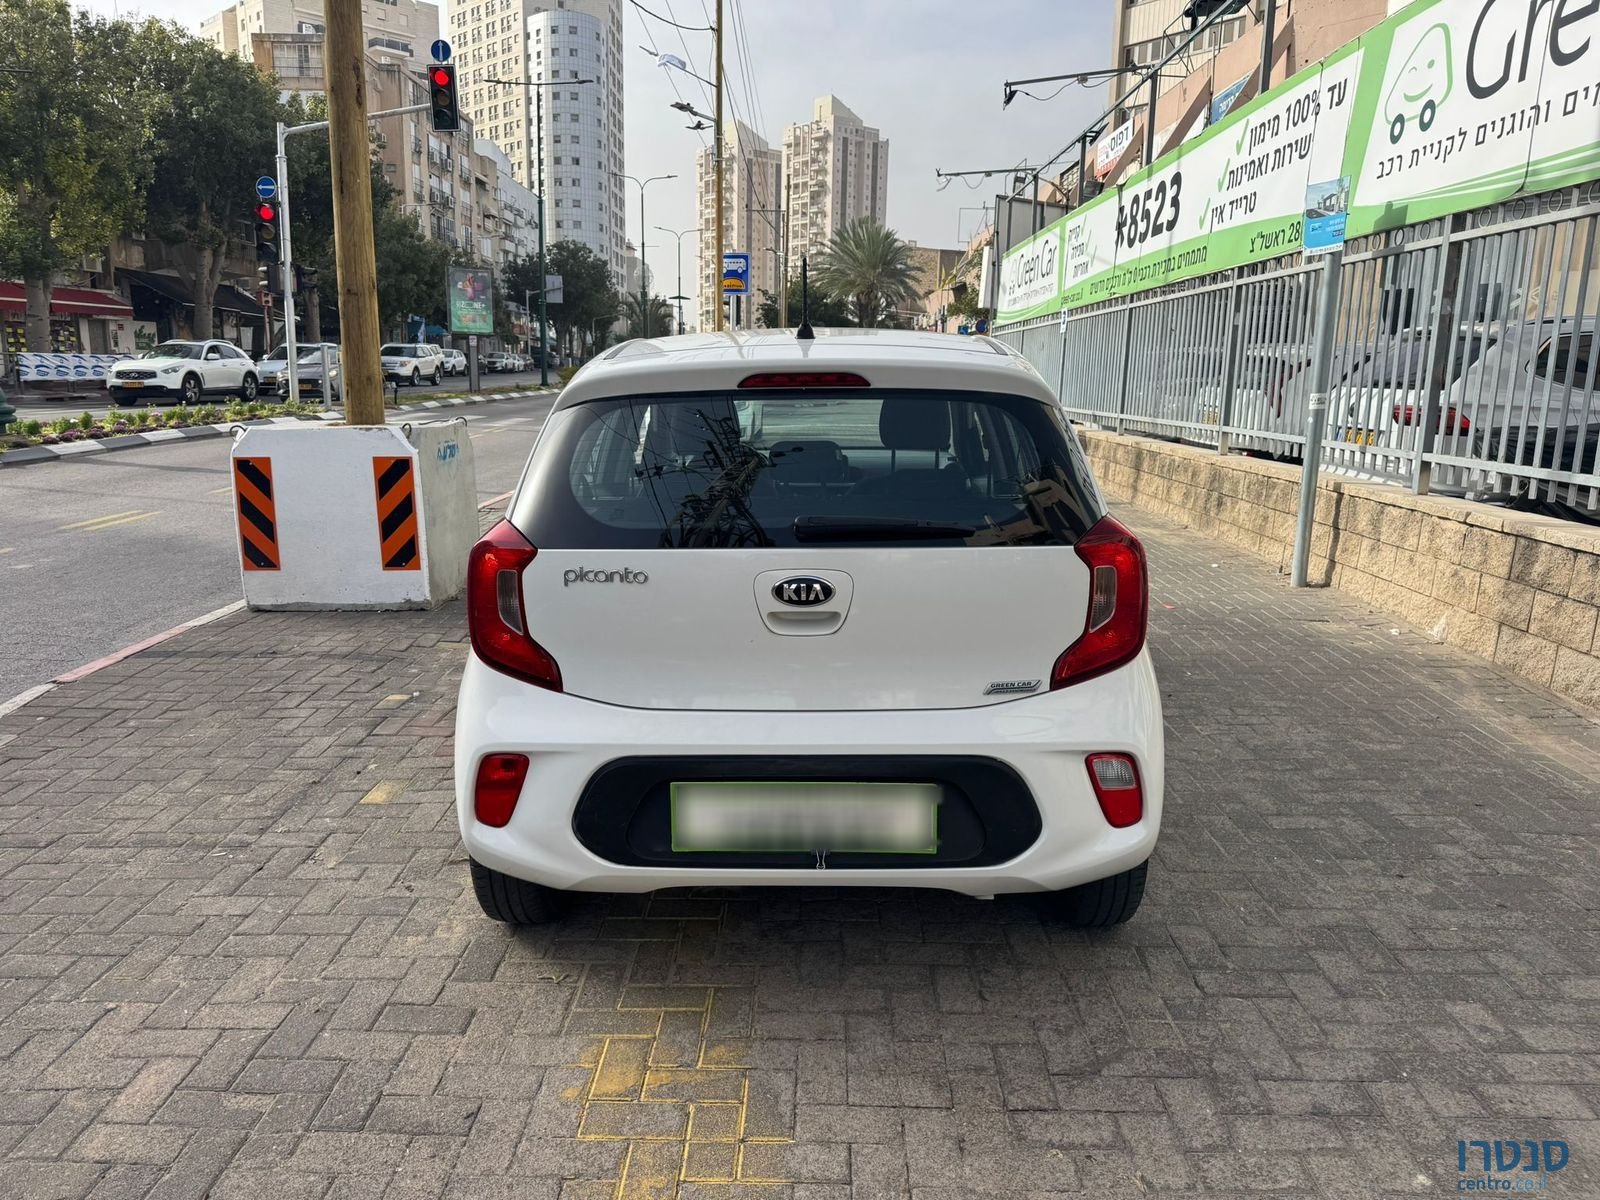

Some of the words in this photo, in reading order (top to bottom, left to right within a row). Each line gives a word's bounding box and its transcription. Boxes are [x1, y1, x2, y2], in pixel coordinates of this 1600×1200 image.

[1327, 78, 1348, 110] עד
[1286, 89, 1321, 131] 100%
[1475, 100, 1551, 146] והוגנים
[1111, 126, 1129, 151] דפוס
[1248, 114, 1280, 156] מימון
[1408, 127, 1468, 169] לקניית
[1271, 133, 1312, 172] שירות
[1376, 155, 1403, 179] רכב
[1226, 153, 1270, 191] ואמינות
[1210, 203, 1226, 234] אין
[1228, 191, 1257, 220] טרייד
[1287, 221, 1301, 243] 28
[1017, 254, 1040, 289] Green
[1041, 239, 1057, 278] Car
[1151, 257, 1176, 278] במכירת
[1177, 245, 1208, 270] מתמחים
[563, 566, 648, 587] picanto
[783, 583, 825, 600] KIA
